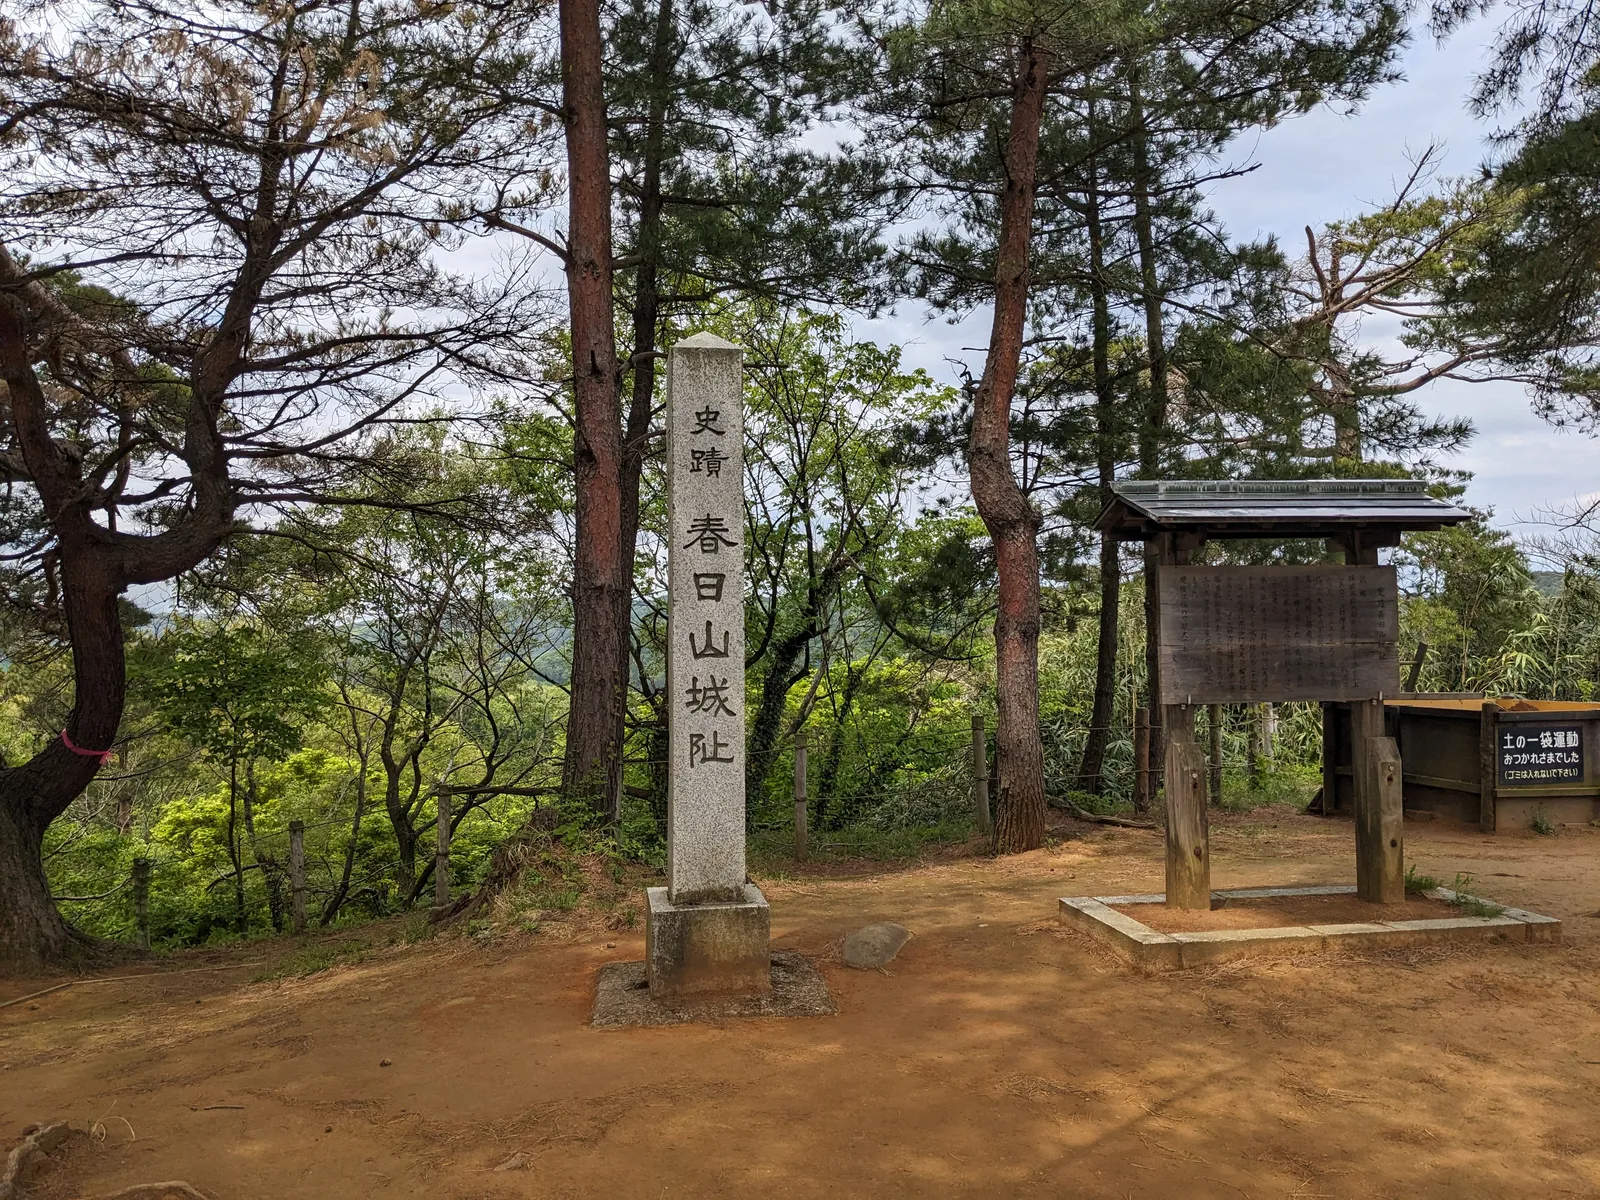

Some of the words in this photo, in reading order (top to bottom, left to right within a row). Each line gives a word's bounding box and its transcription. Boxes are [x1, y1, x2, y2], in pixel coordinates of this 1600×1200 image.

[1503, 731, 1579, 749] 土の一袋運動
[1504, 751, 1579, 765] おつかれさまでした
